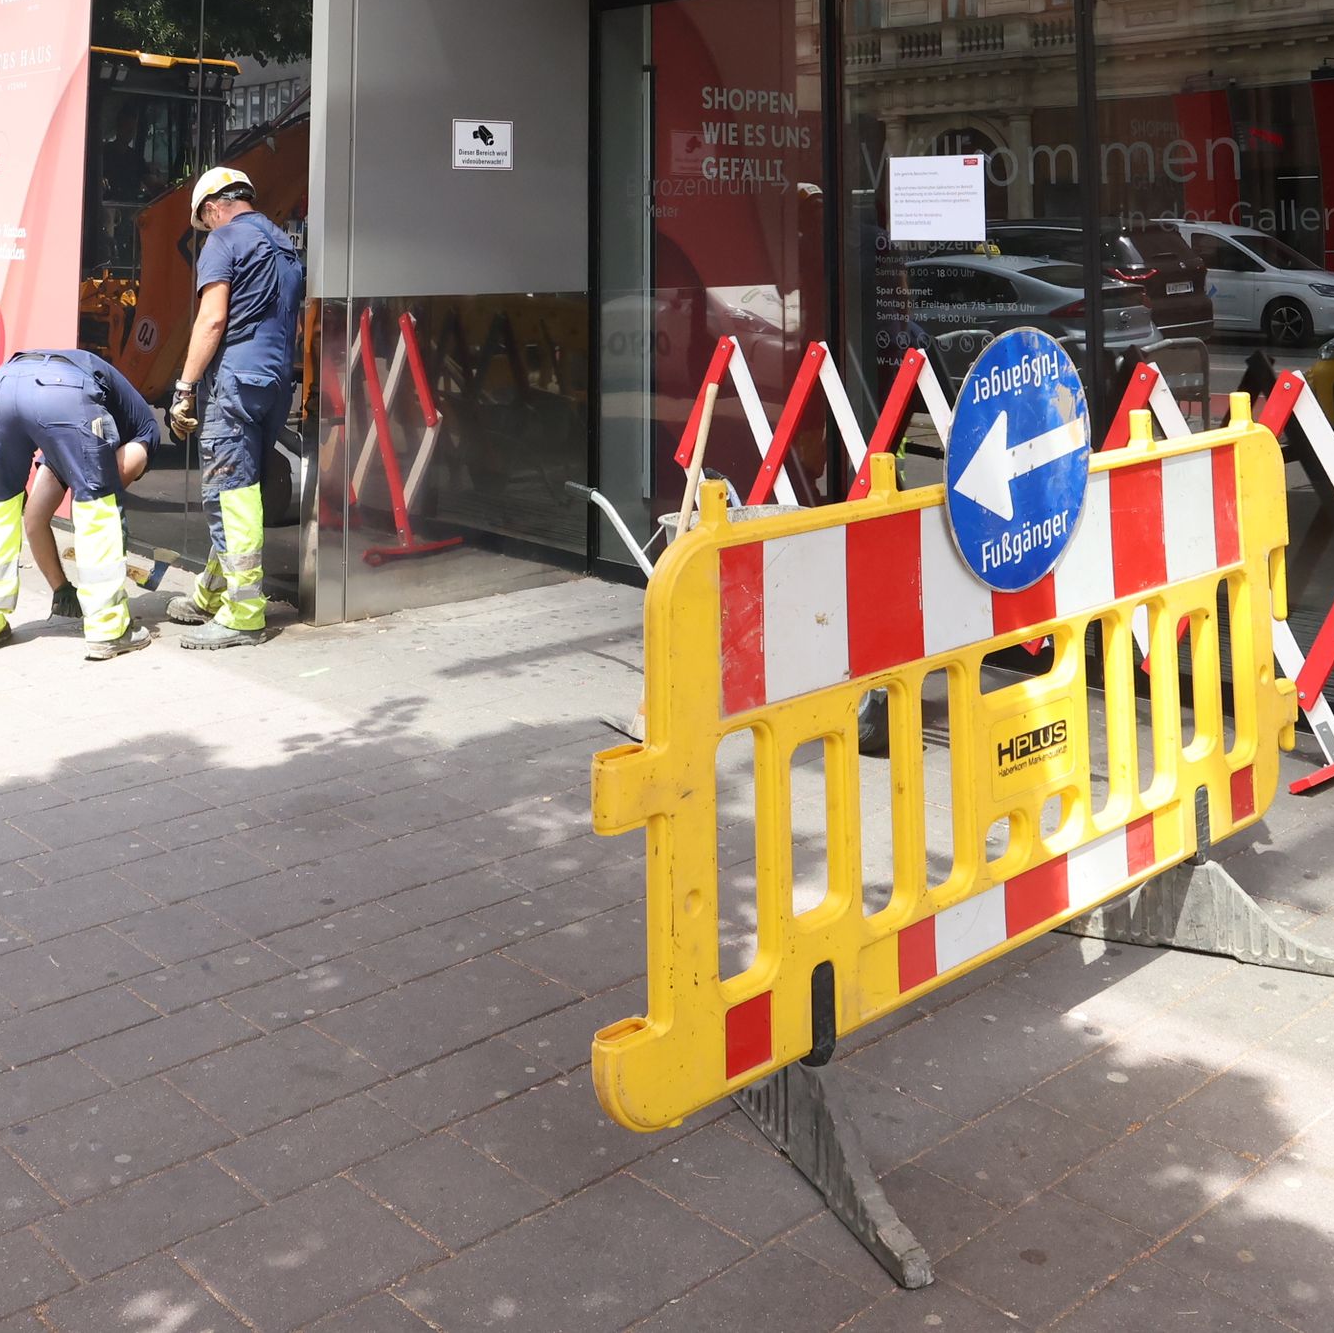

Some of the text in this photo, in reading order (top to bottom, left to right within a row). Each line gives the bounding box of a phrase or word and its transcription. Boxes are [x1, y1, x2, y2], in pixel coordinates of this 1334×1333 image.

[702, 86, 799, 119] SHOPPEN,
[702, 121, 811, 150] WIE ES UNS
[458, 148, 475, 156] Dieser
[476, 149, 495, 157] Bereich
[702, 156, 783, 182] GEFÄLLT
[876, 286, 934, 296] Spar Gourmet:
[876, 299, 906, 310] Montag
[907, 299, 919, 309] bis
[921, 300, 950, 311] Freitag
[952, 301, 967, 310] von
[995, 302, 1018, 312] 19.30
[1020, 303, 1037, 313] Uhr
[876, 313, 909, 323] Samstag
[938, 313, 960, 323] 18.00
[962, 314, 978, 323] Uhr
[876, 356, 903, 366] W-LA
[972, 350, 1060, 404] Fußgänger
[981, 510, 1069, 573] Fußgänger
[997, 719, 1068, 767] HPLUS
